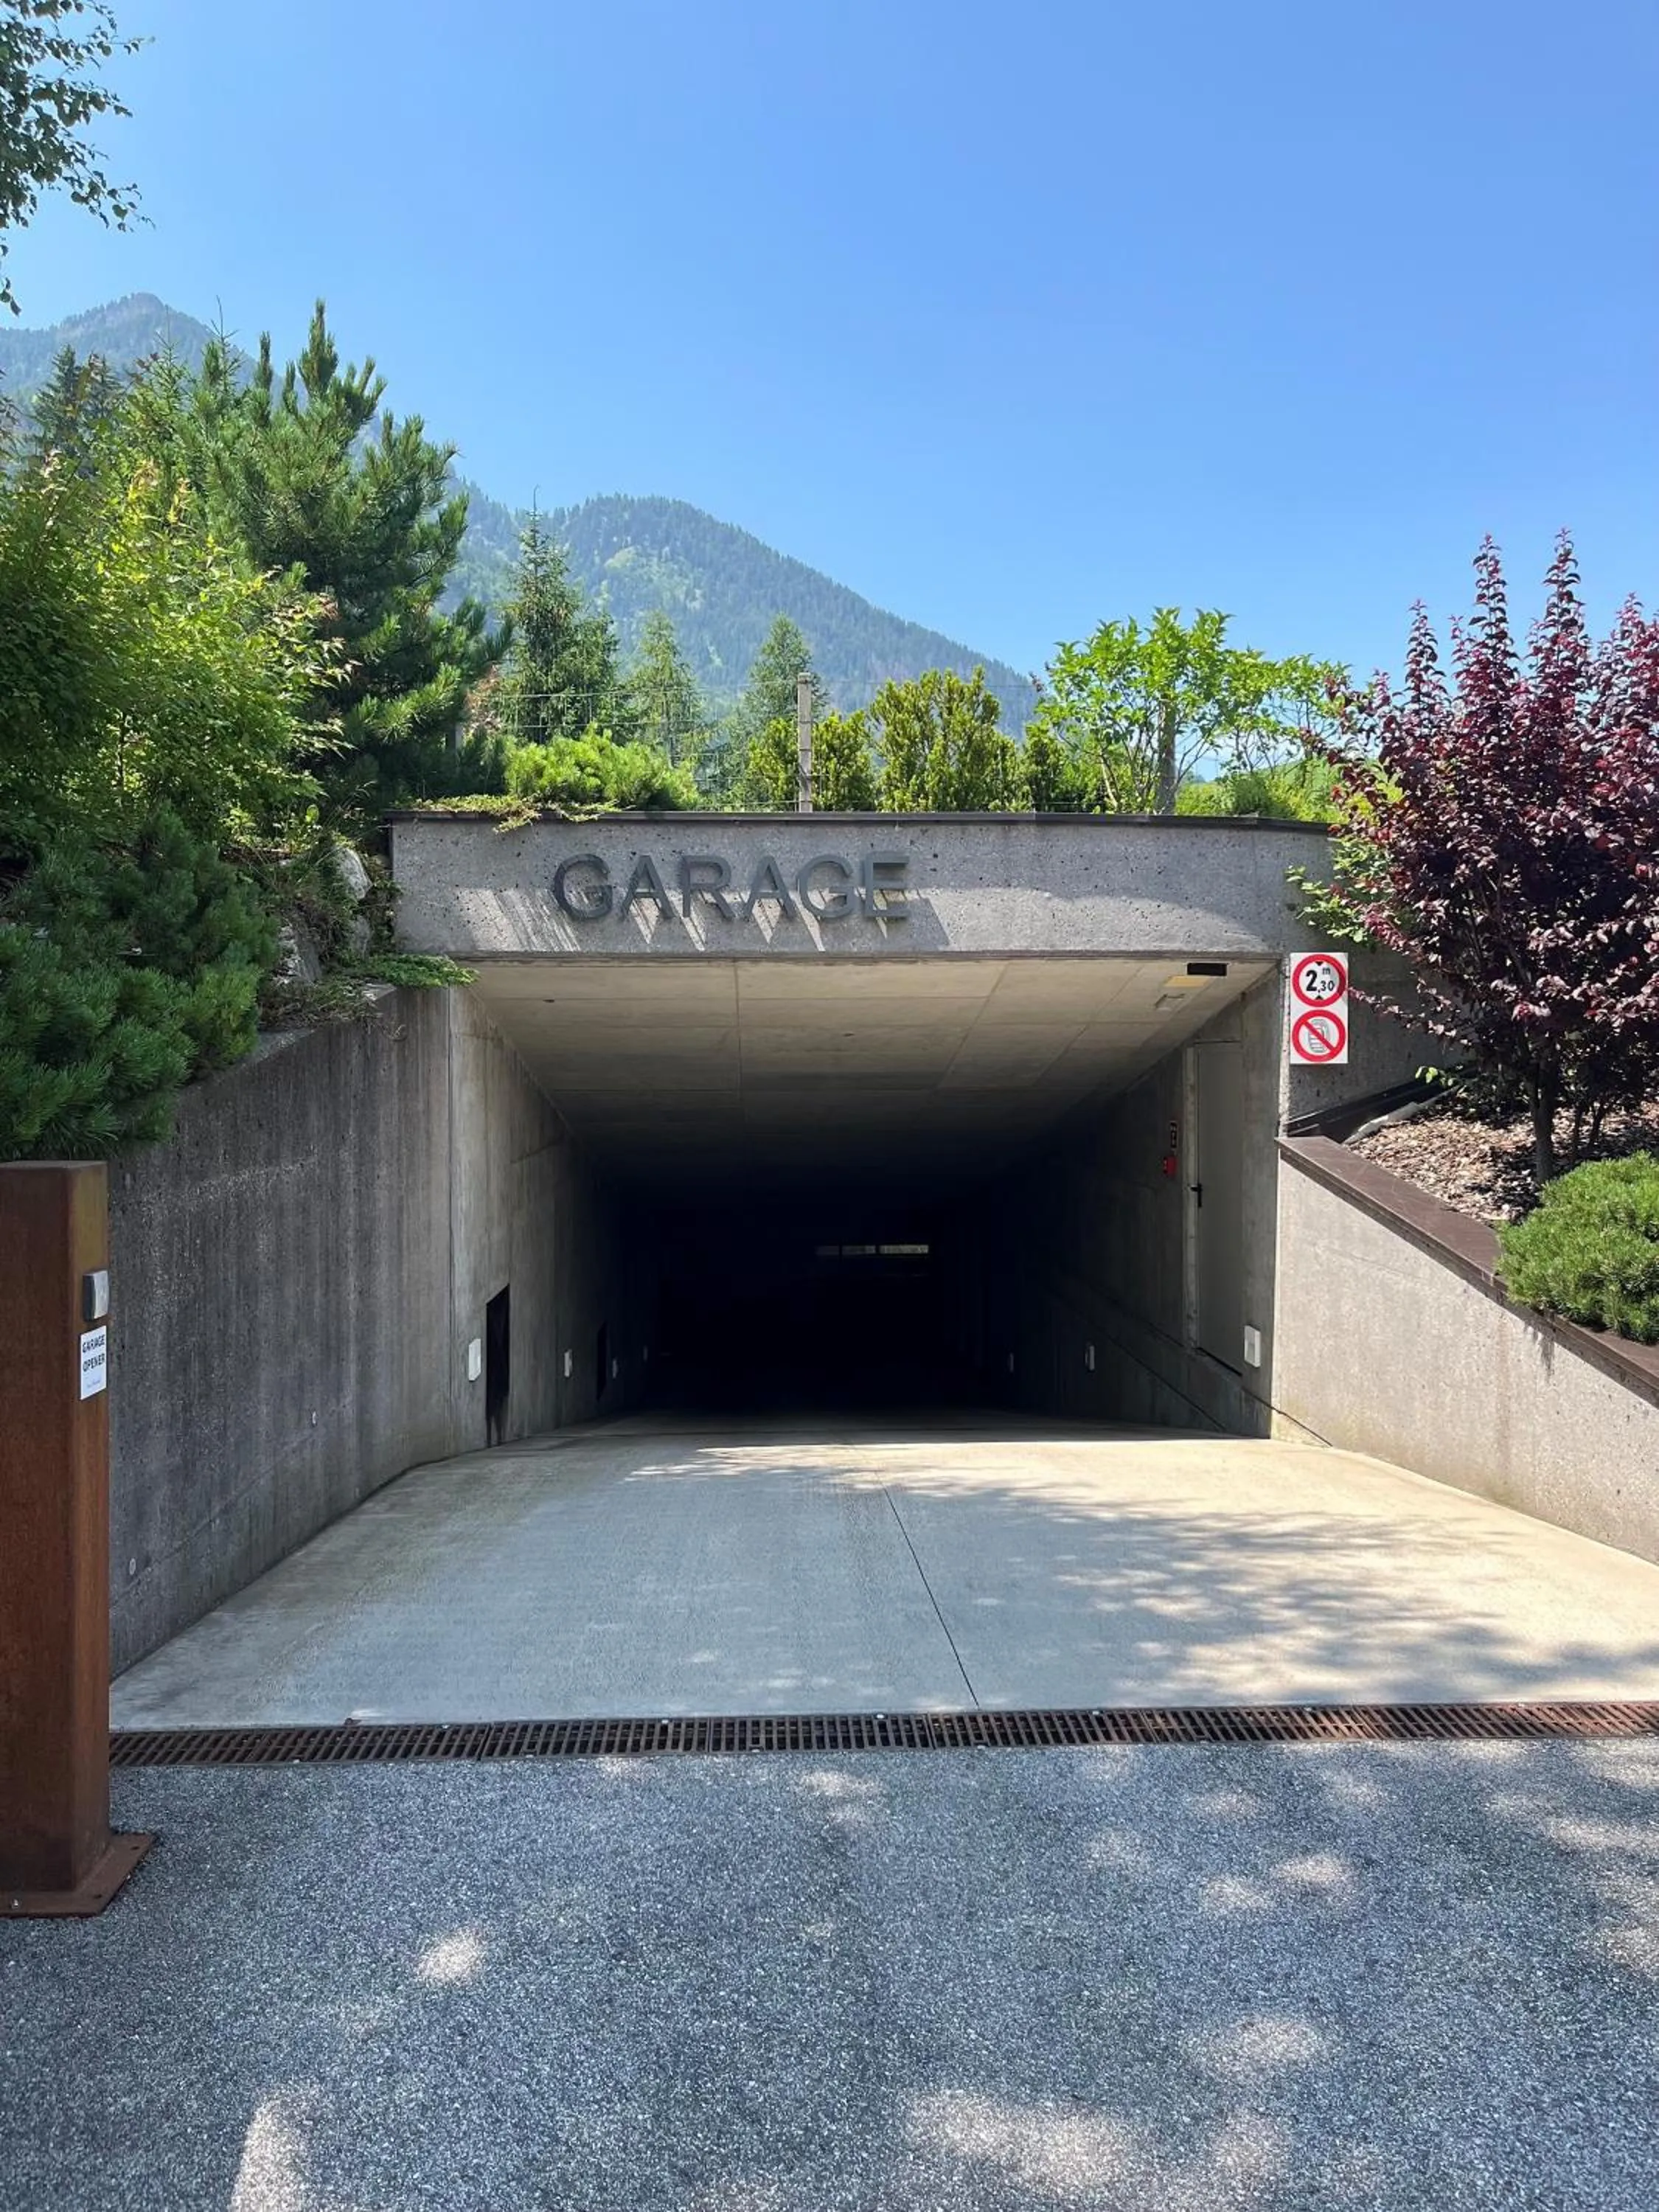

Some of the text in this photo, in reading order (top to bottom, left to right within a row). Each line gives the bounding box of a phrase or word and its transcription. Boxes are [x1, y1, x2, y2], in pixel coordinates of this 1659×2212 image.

[553, 852, 911, 921] GARAGE
[83, 1334, 105, 1353] GARAGE
[83, 1353, 105, 1371] OPENER
